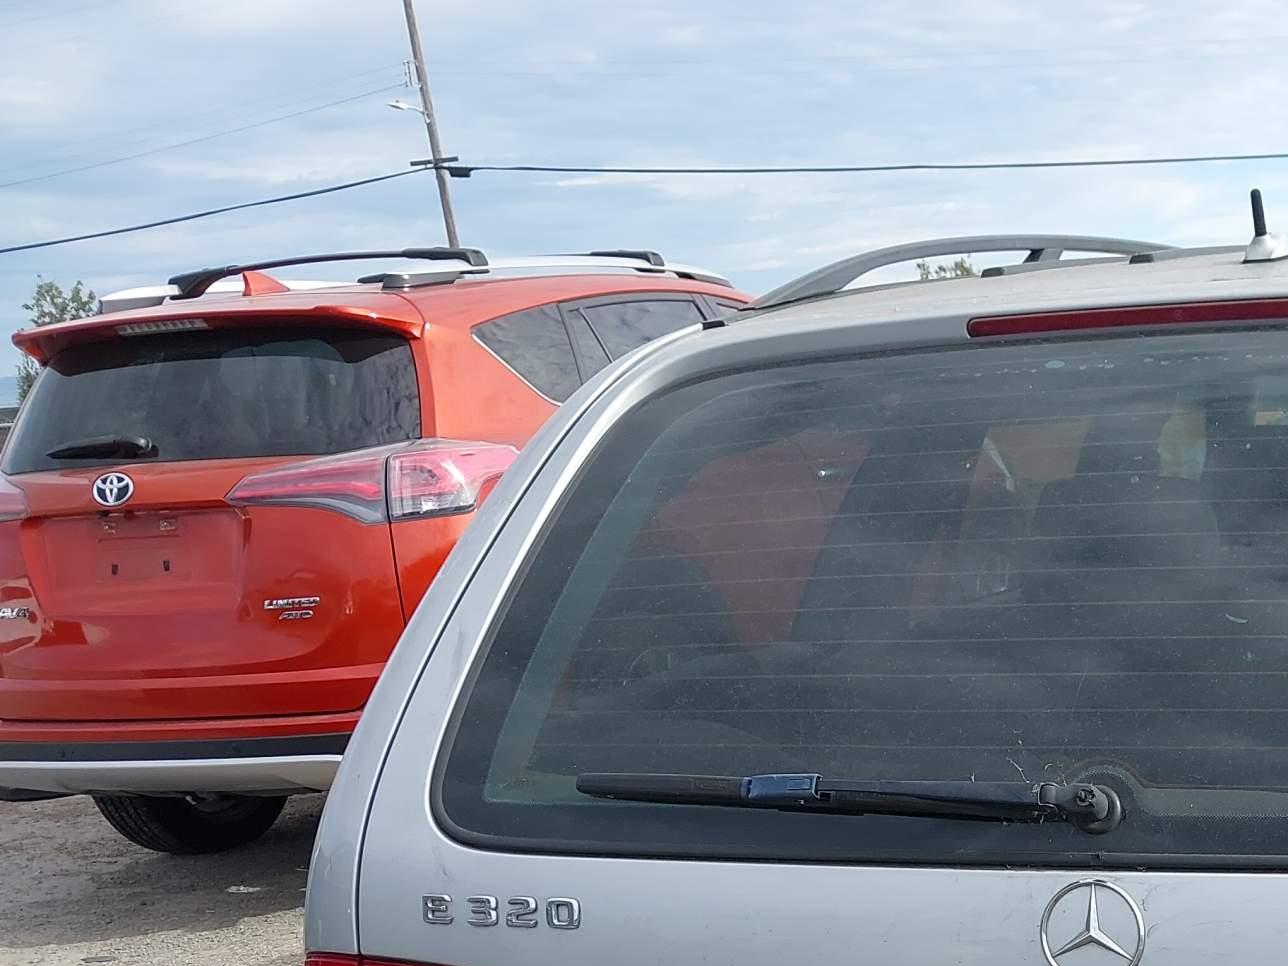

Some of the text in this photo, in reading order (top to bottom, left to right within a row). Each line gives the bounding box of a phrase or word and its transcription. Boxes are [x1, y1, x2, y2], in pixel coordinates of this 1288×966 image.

[263, 596, 320, 610] LIMITED
[422, 893, 582, 930] E 320
